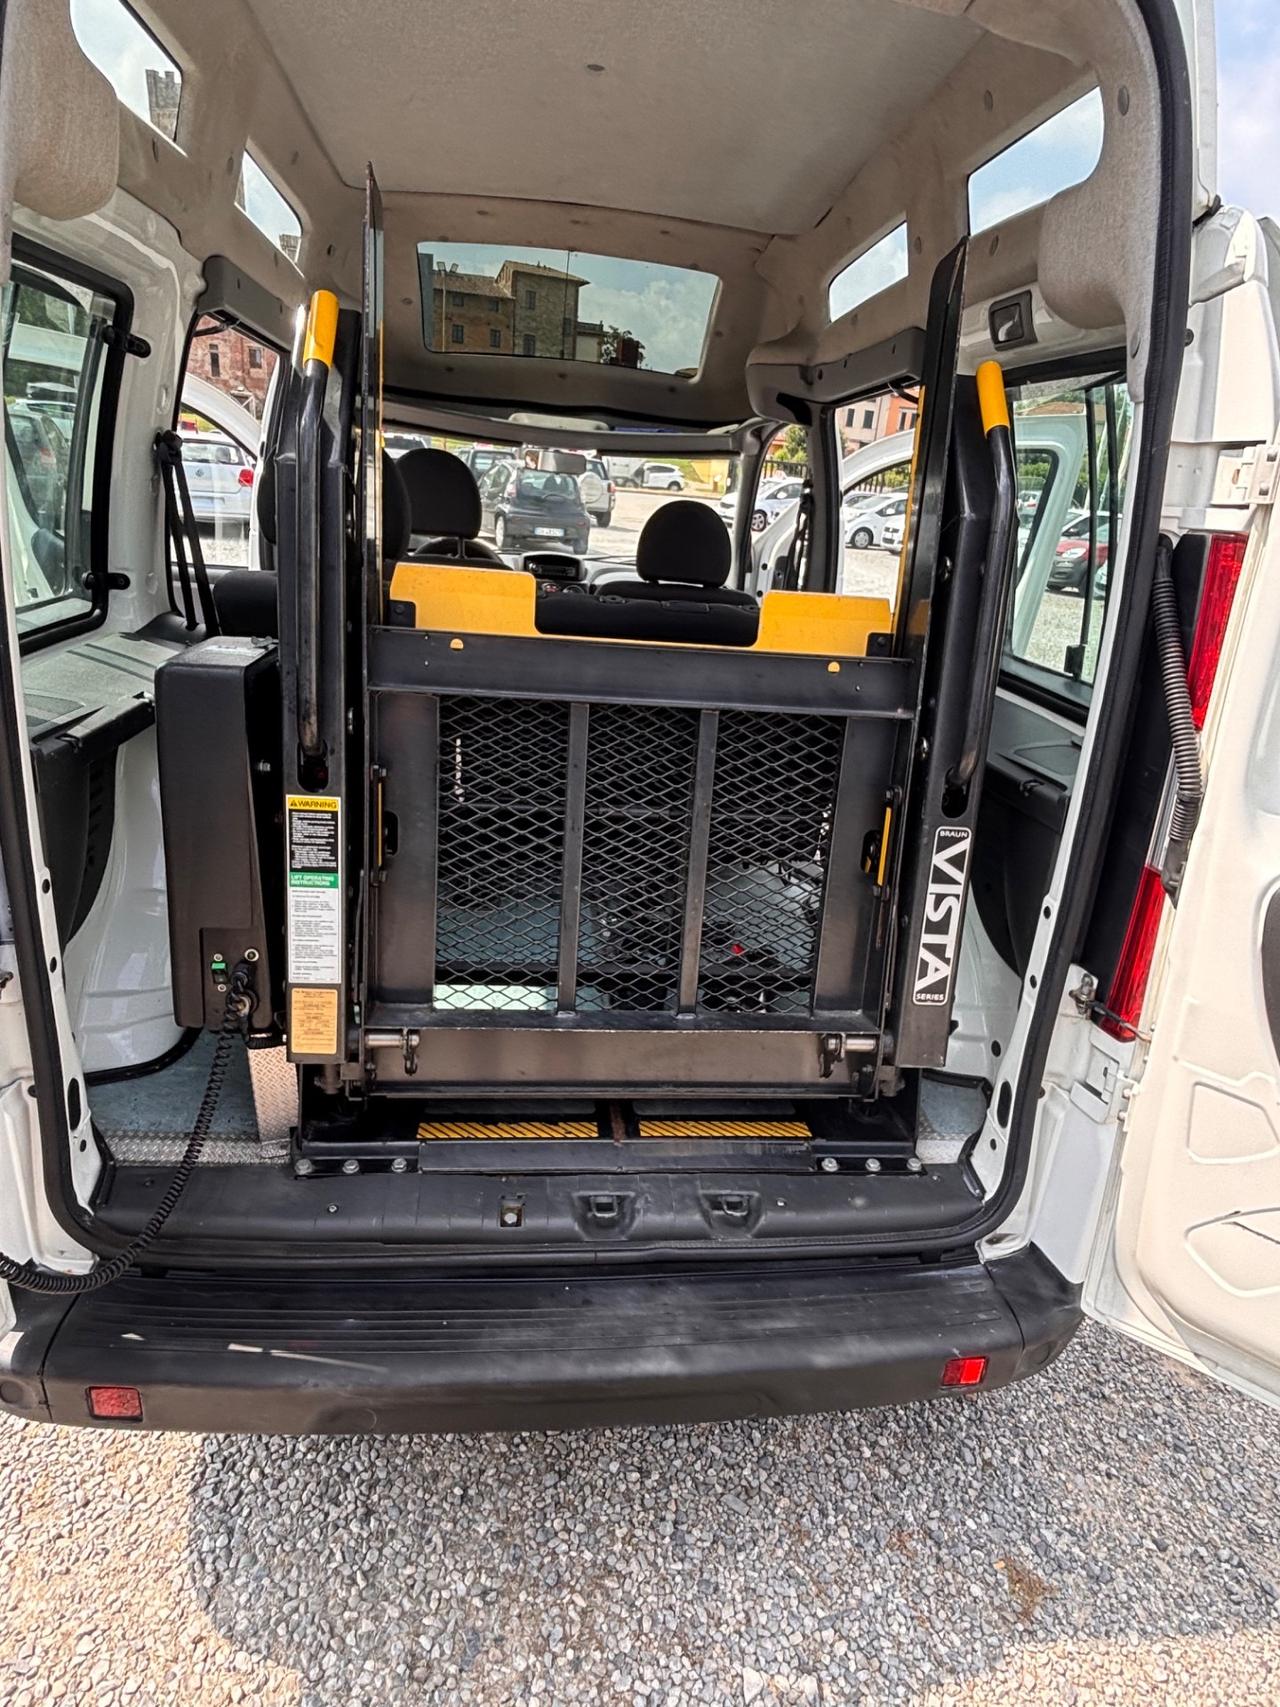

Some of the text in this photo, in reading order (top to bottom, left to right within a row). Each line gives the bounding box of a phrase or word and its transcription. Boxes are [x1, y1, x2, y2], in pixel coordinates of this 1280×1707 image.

[298, 800, 337, 809] WARNING
[939, 829, 968, 839] BRAUN
[914, 838, 971, 992] VISTA
[916, 992, 944, 1001] SERIES
